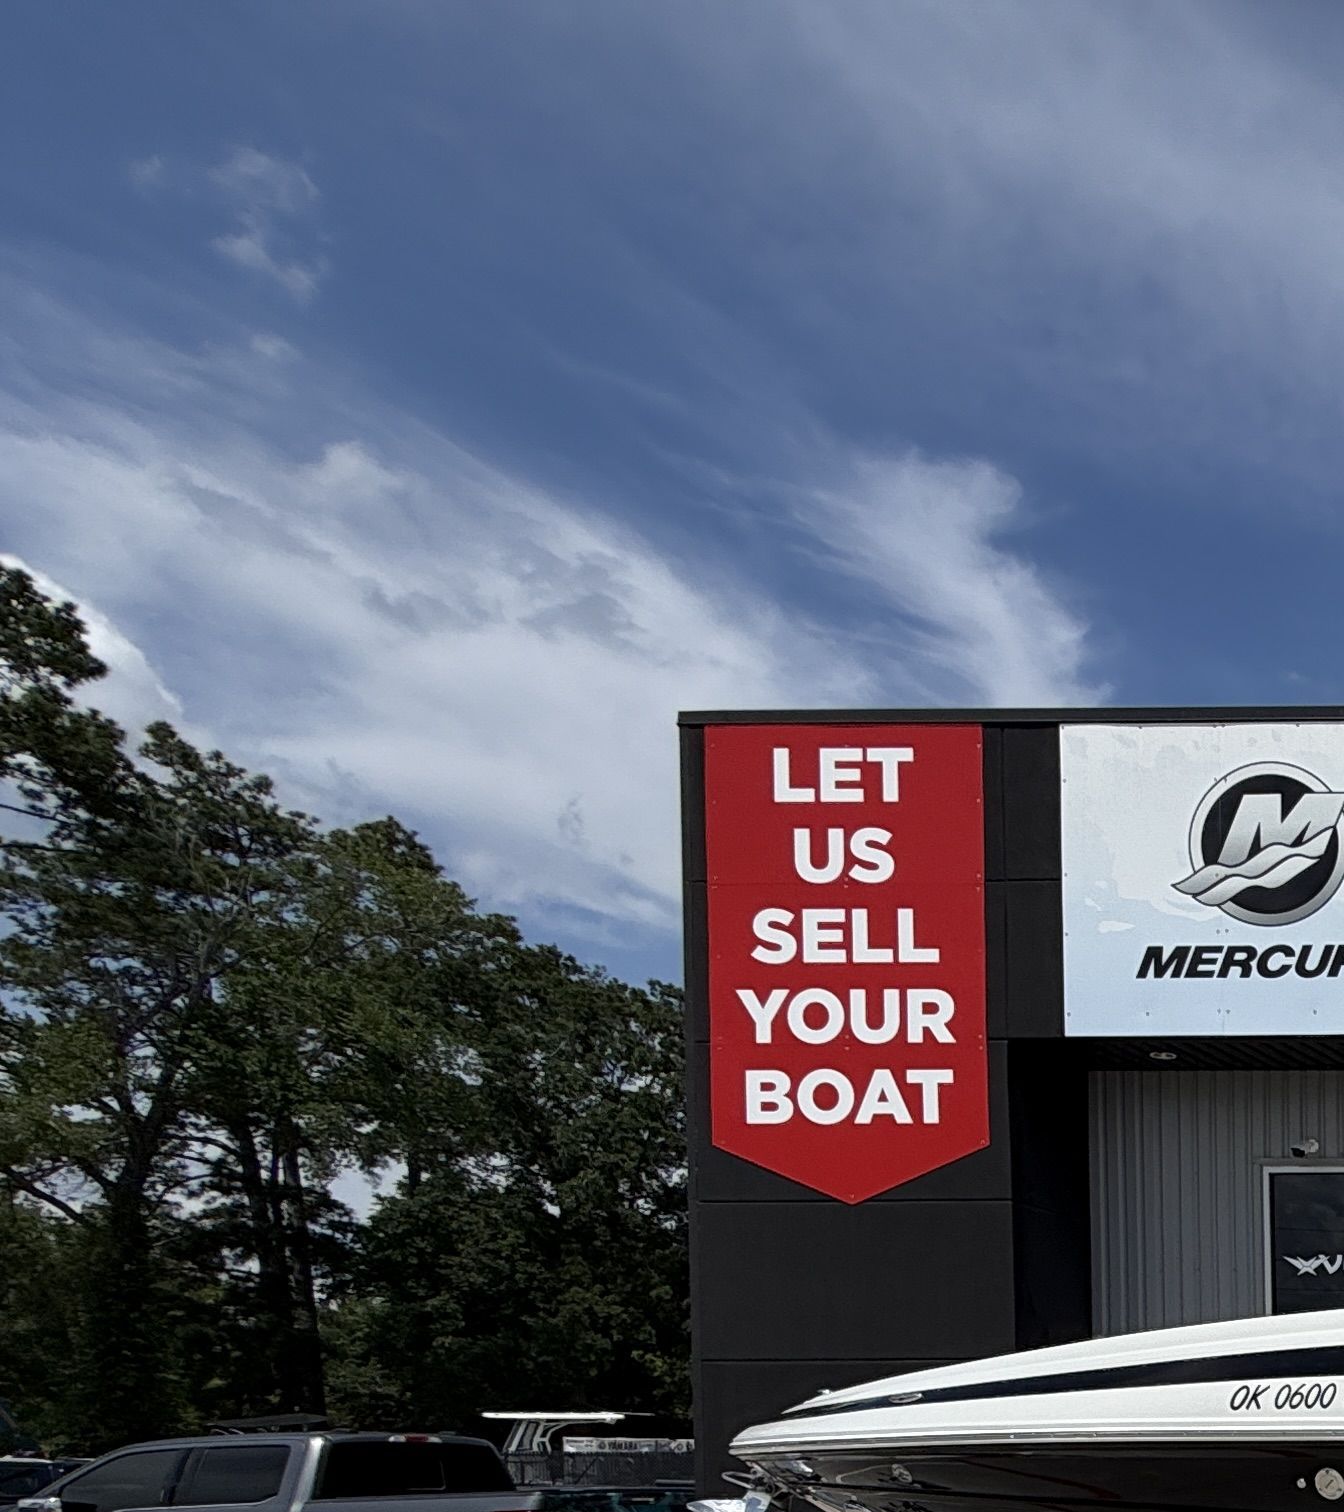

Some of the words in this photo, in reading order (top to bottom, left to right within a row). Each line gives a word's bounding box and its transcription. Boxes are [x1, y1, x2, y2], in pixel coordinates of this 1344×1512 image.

[772, 747, 914, 803] LET
[793, 827, 895, 885] US
[750, 908, 940, 965] SELL
[736, 988, 956, 1045] YOUR
[744, 1068, 955, 1126] BOAT
[1229, 1384, 1271, 1411] OK
[1274, 1383, 1337, 1410] 0600
